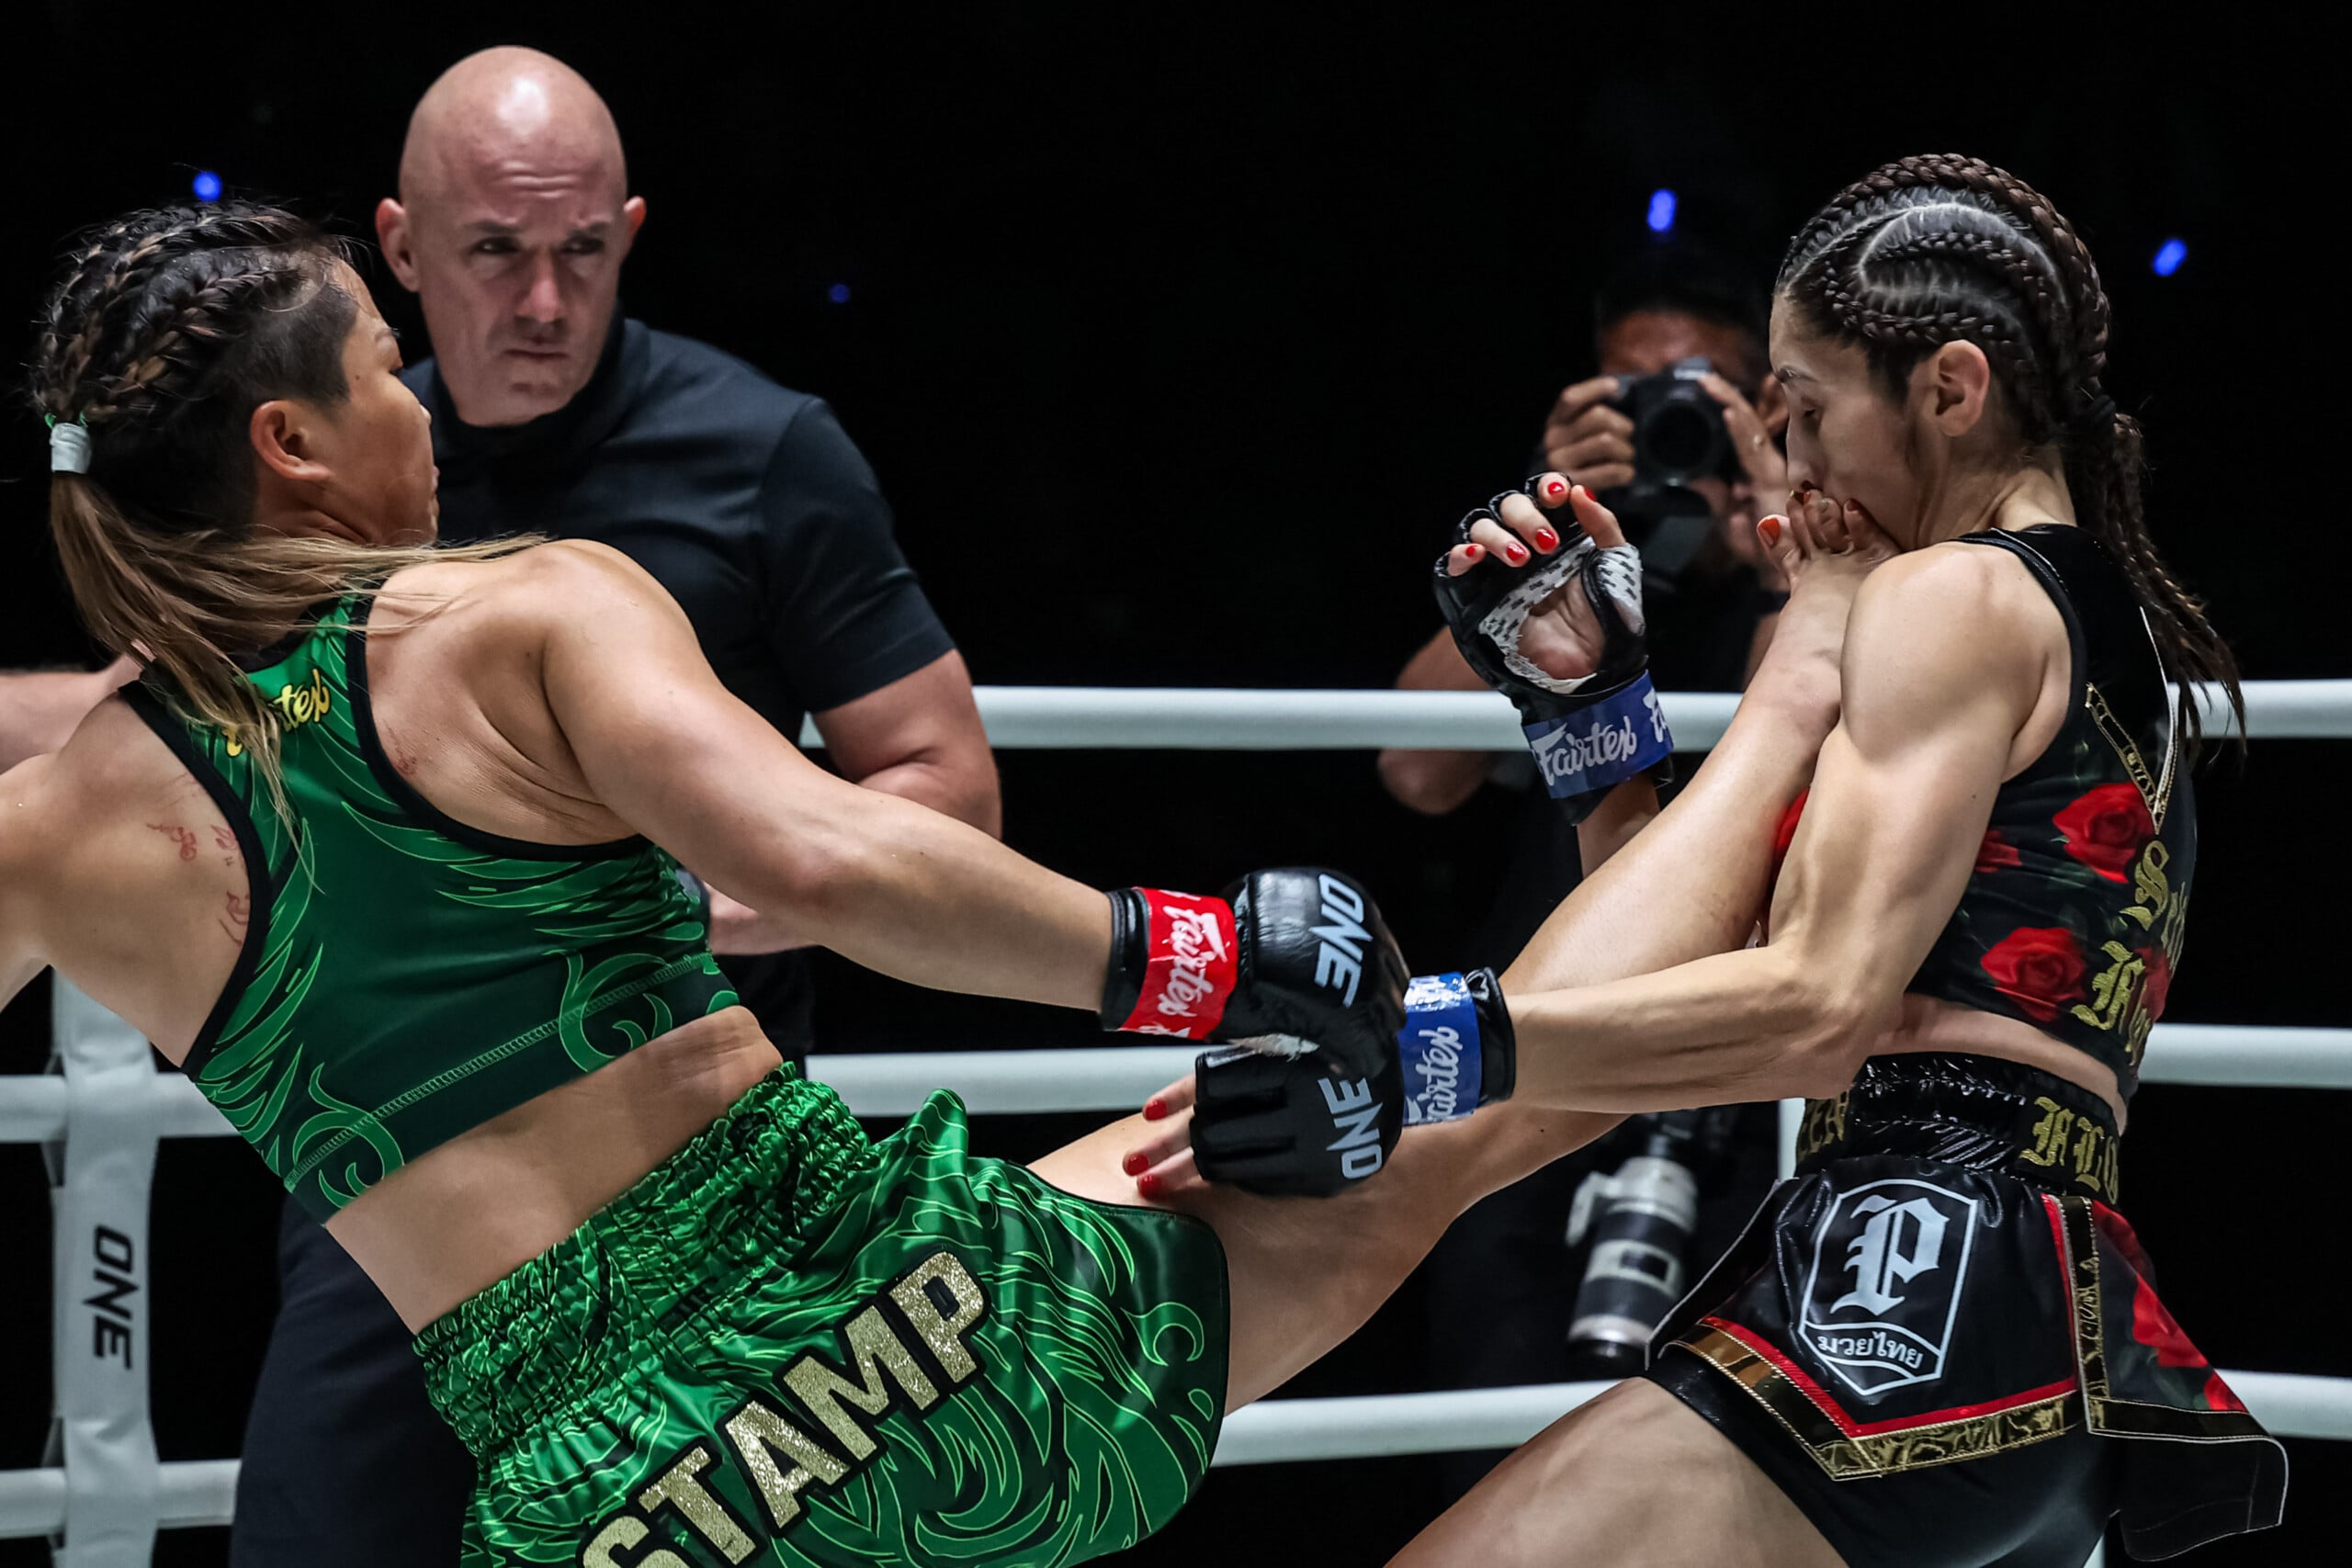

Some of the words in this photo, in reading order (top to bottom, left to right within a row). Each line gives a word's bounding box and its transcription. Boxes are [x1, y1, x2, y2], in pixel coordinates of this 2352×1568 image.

[1531, 716, 1637, 786] Fairtex
[1158, 905, 1227, 1017] Fairtex
[1308, 873, 1374, 1008] ONE
[1317, 1077, 1383, 1179] ONE
[83, 1224, 139, 1370] ONE
[1829, 1195, 1951, 1316] P
[1817, 1331, 1924, 1369] มวยไทย
[582, 1251, 987, 1568] STAMP
